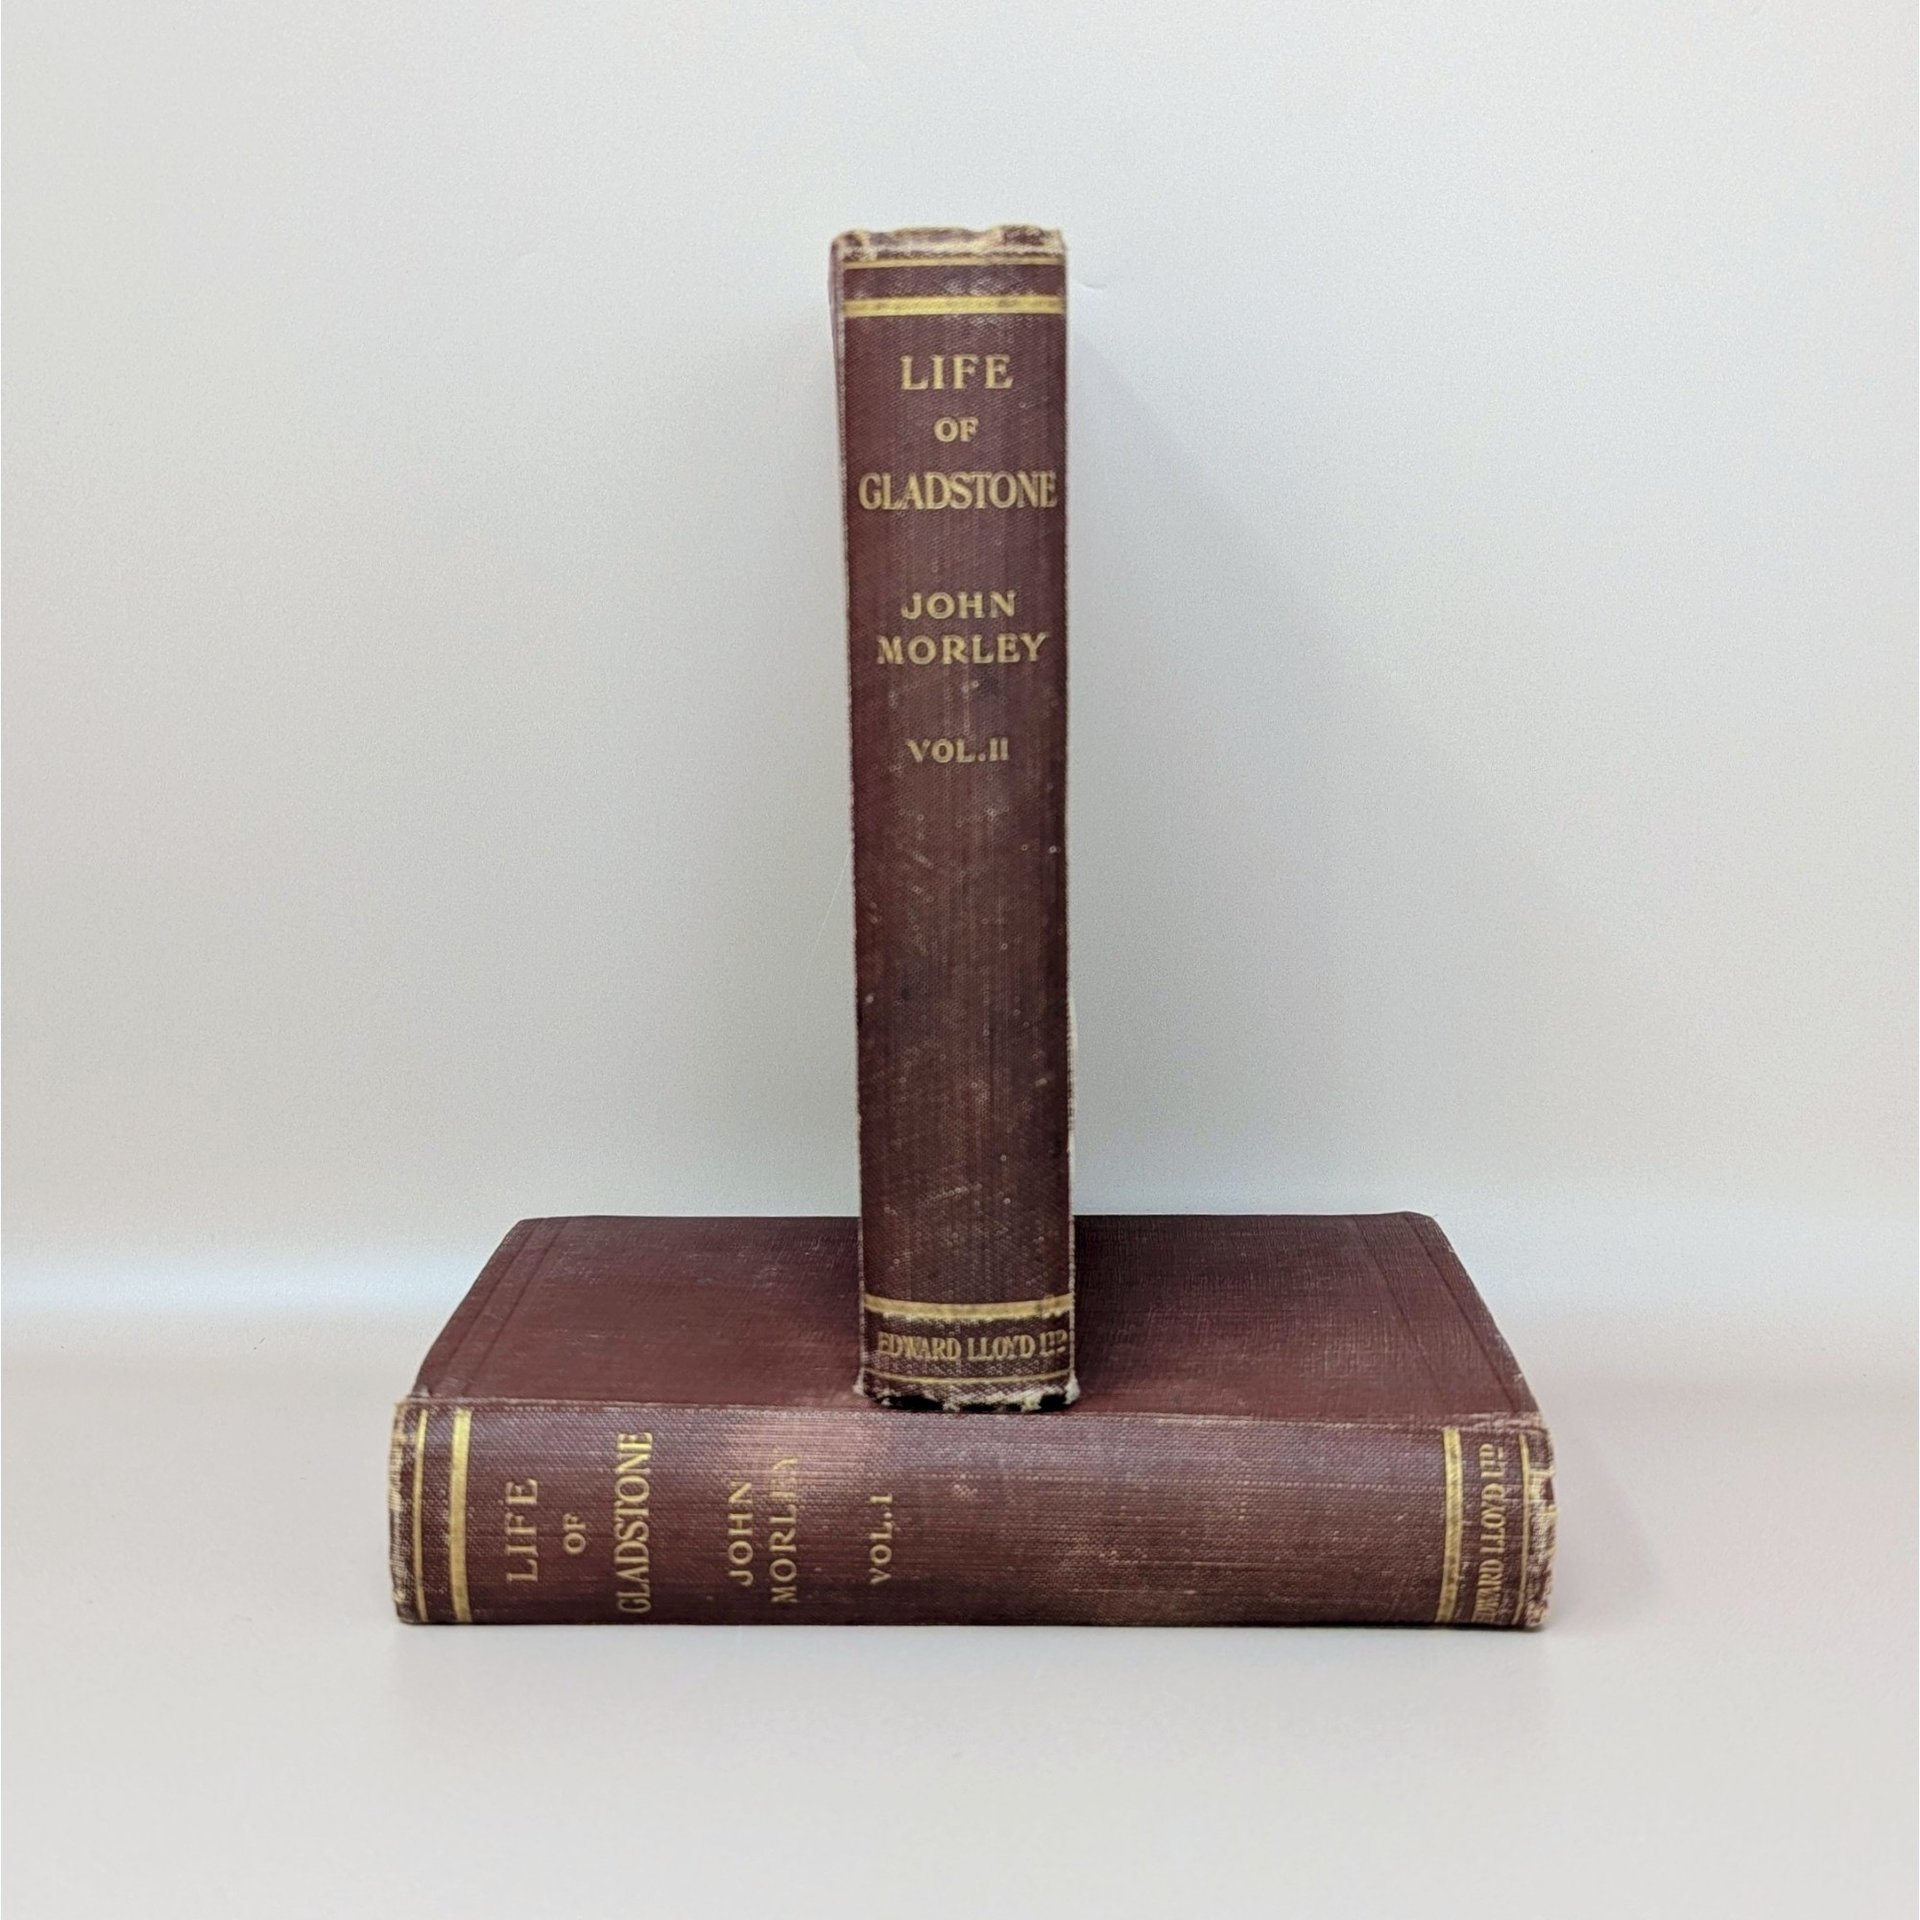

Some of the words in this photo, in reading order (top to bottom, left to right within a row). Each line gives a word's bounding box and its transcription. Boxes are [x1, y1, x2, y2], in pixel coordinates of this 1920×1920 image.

[900, 354, 1014, 390] LIFE
[933, 416, 979, 443] OF
[858, 470, 1058, 510] GLADSTONE
[901, 590, 1018, 620] JOHN
[877, 632, 1049, 665] MORLEY
[877, 1331, 962, 1361] EDWARD
[967, 1333, 1037, 1362] LLOYD
[505, 1478, 539, 1583] LIFE
[562, 1513, 587, 1555] OF
[614, 1431, 653, 1614] GLADSTONE
[728, 1481, 754, 1587] JOHN
[1480, 1482, 1507, 1554] LLOYD
